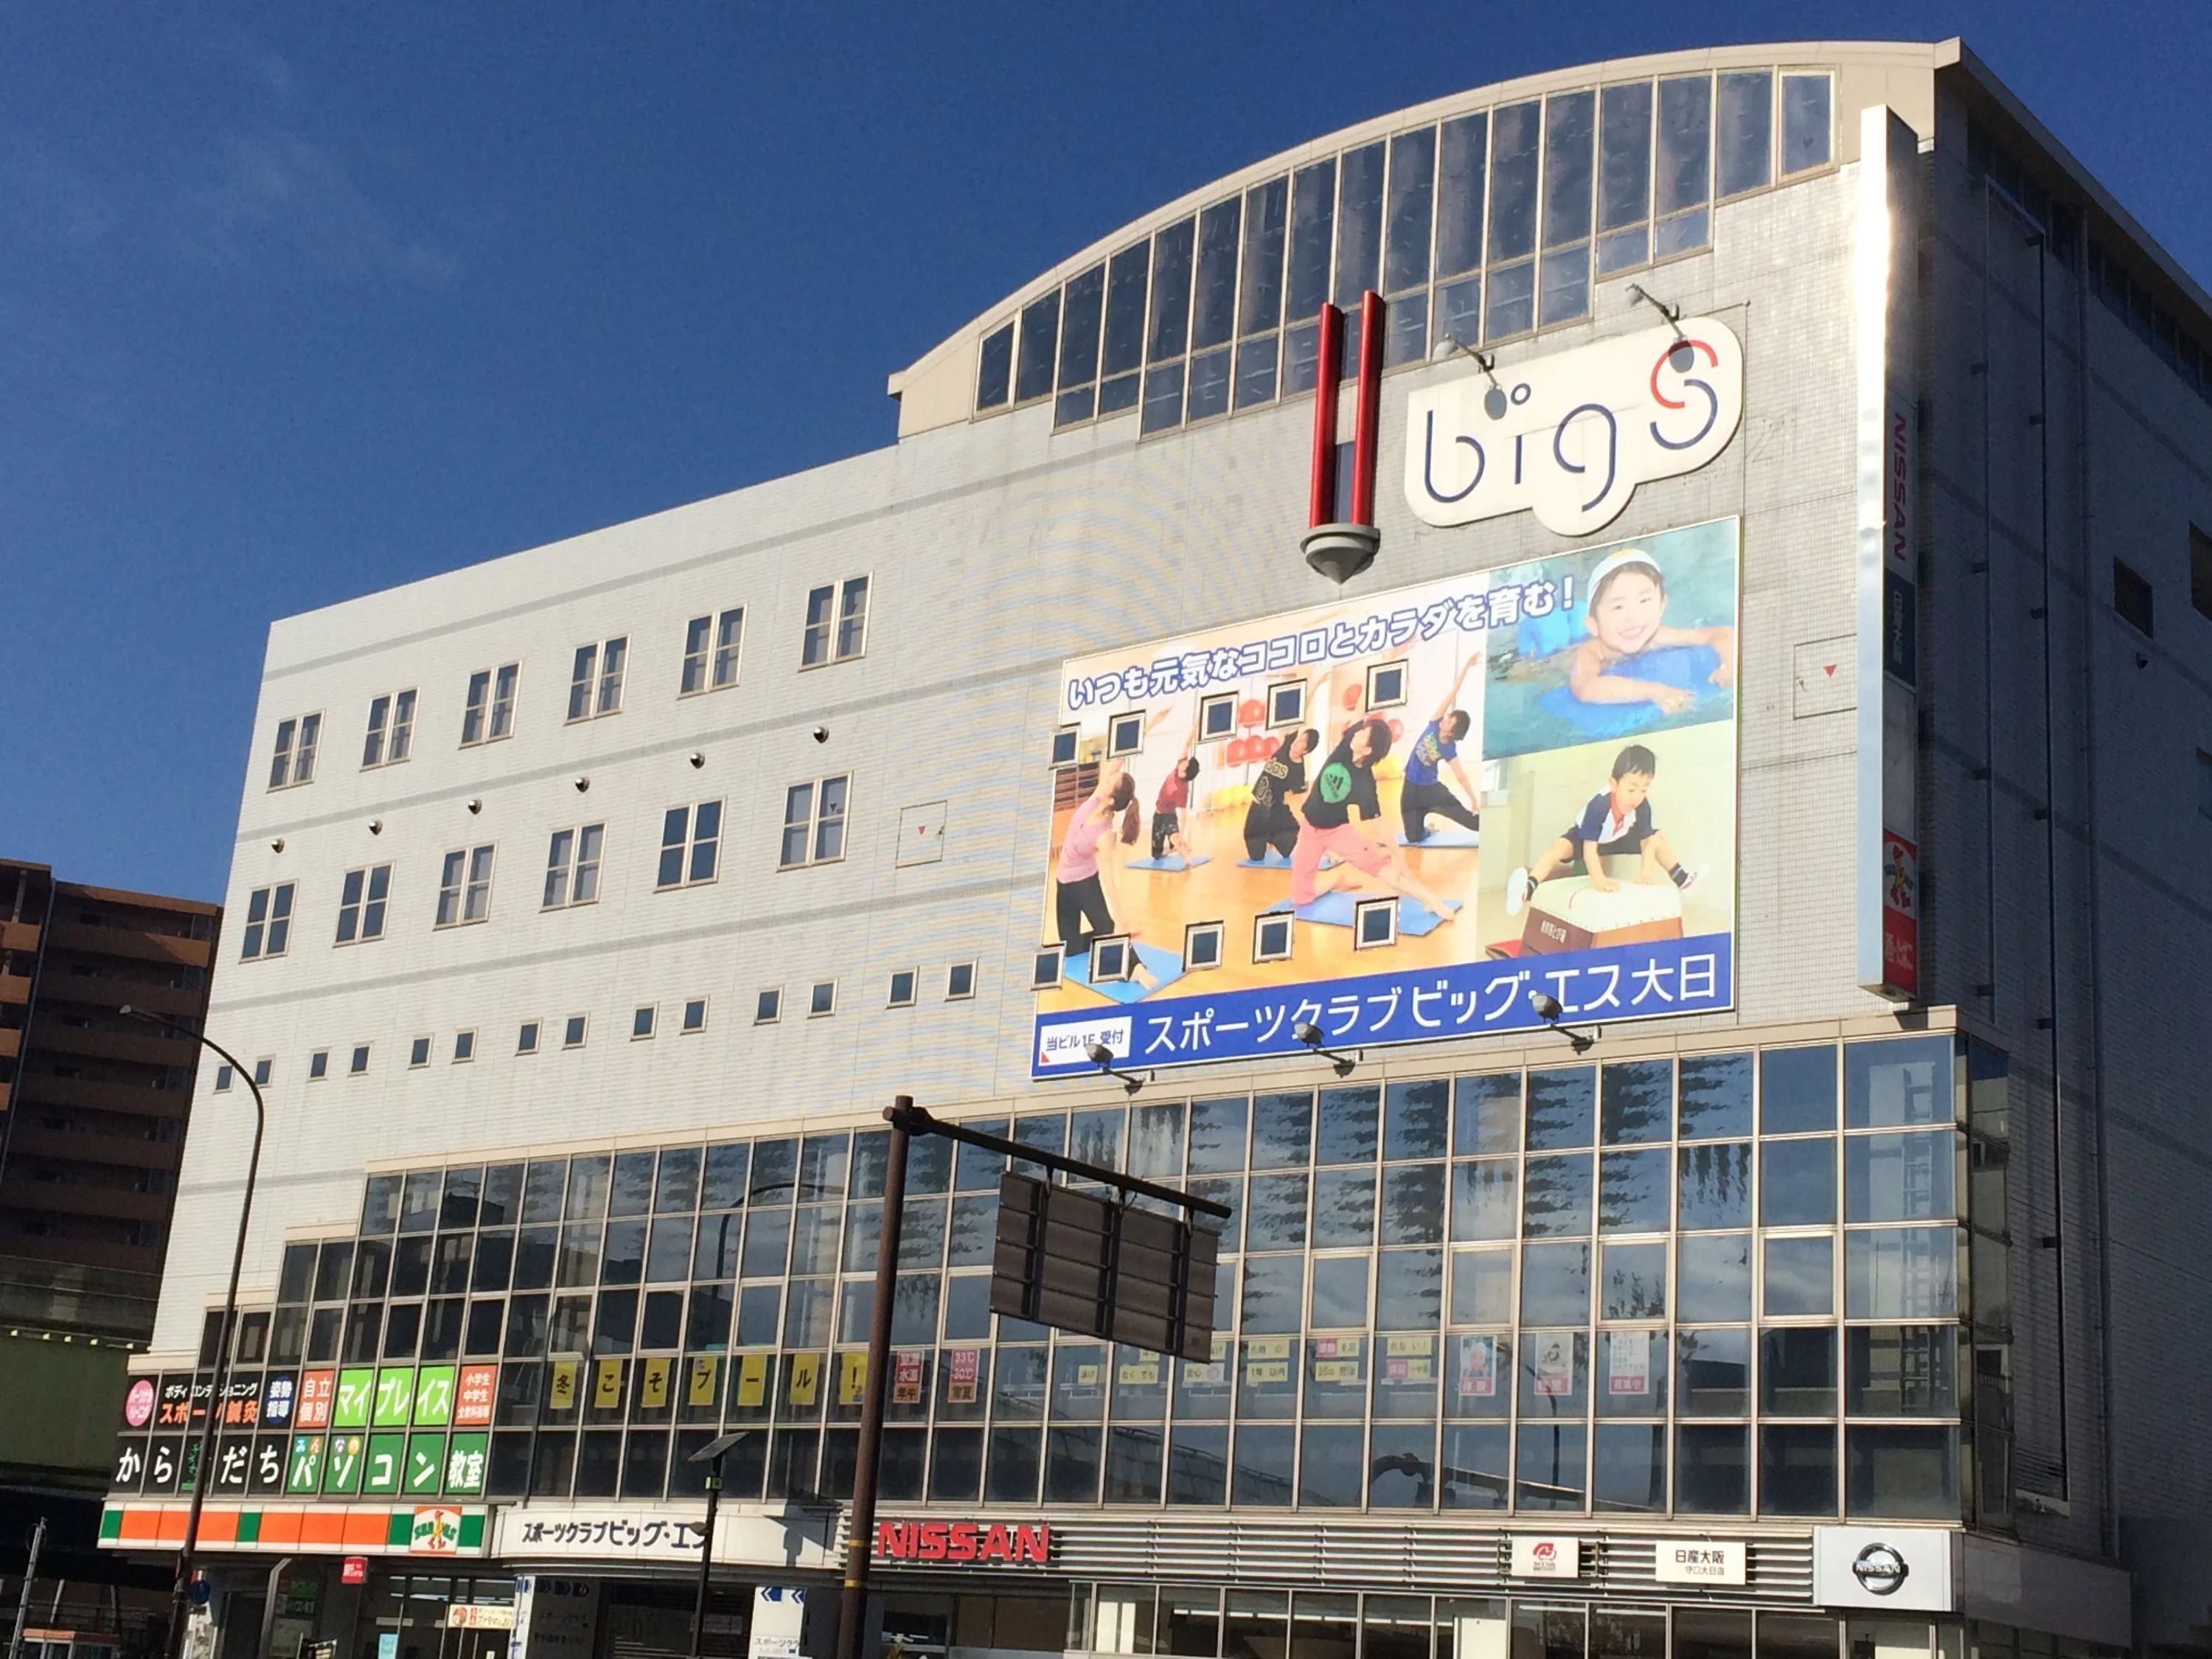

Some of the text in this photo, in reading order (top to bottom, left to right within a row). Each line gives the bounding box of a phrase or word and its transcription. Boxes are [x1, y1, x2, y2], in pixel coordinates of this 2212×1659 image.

[1893, 411, 1907, 563] NISSAN
[1068, 574, 1575, 711] いつも元気なココロとカラダを育む!
[1099, 1029, 1124, 1047] 受付
[303, 1377, 333, 1398] 自立
[465, 1371, 491, 1387] 小学生
[338, 1376, 450, 1418] マイプレイス
[462, 1388, 490, 1402] 中学生
[299, 1401, 329, 1422] 個別
[292, 1450, 484, 1489] パソコン教室
[876, 1520, 1051, 1563] NISSAN
[1675, 1549, 1725, 1565] 日産大阪
[1855, 1564, 1902, 1575] NISSAN
